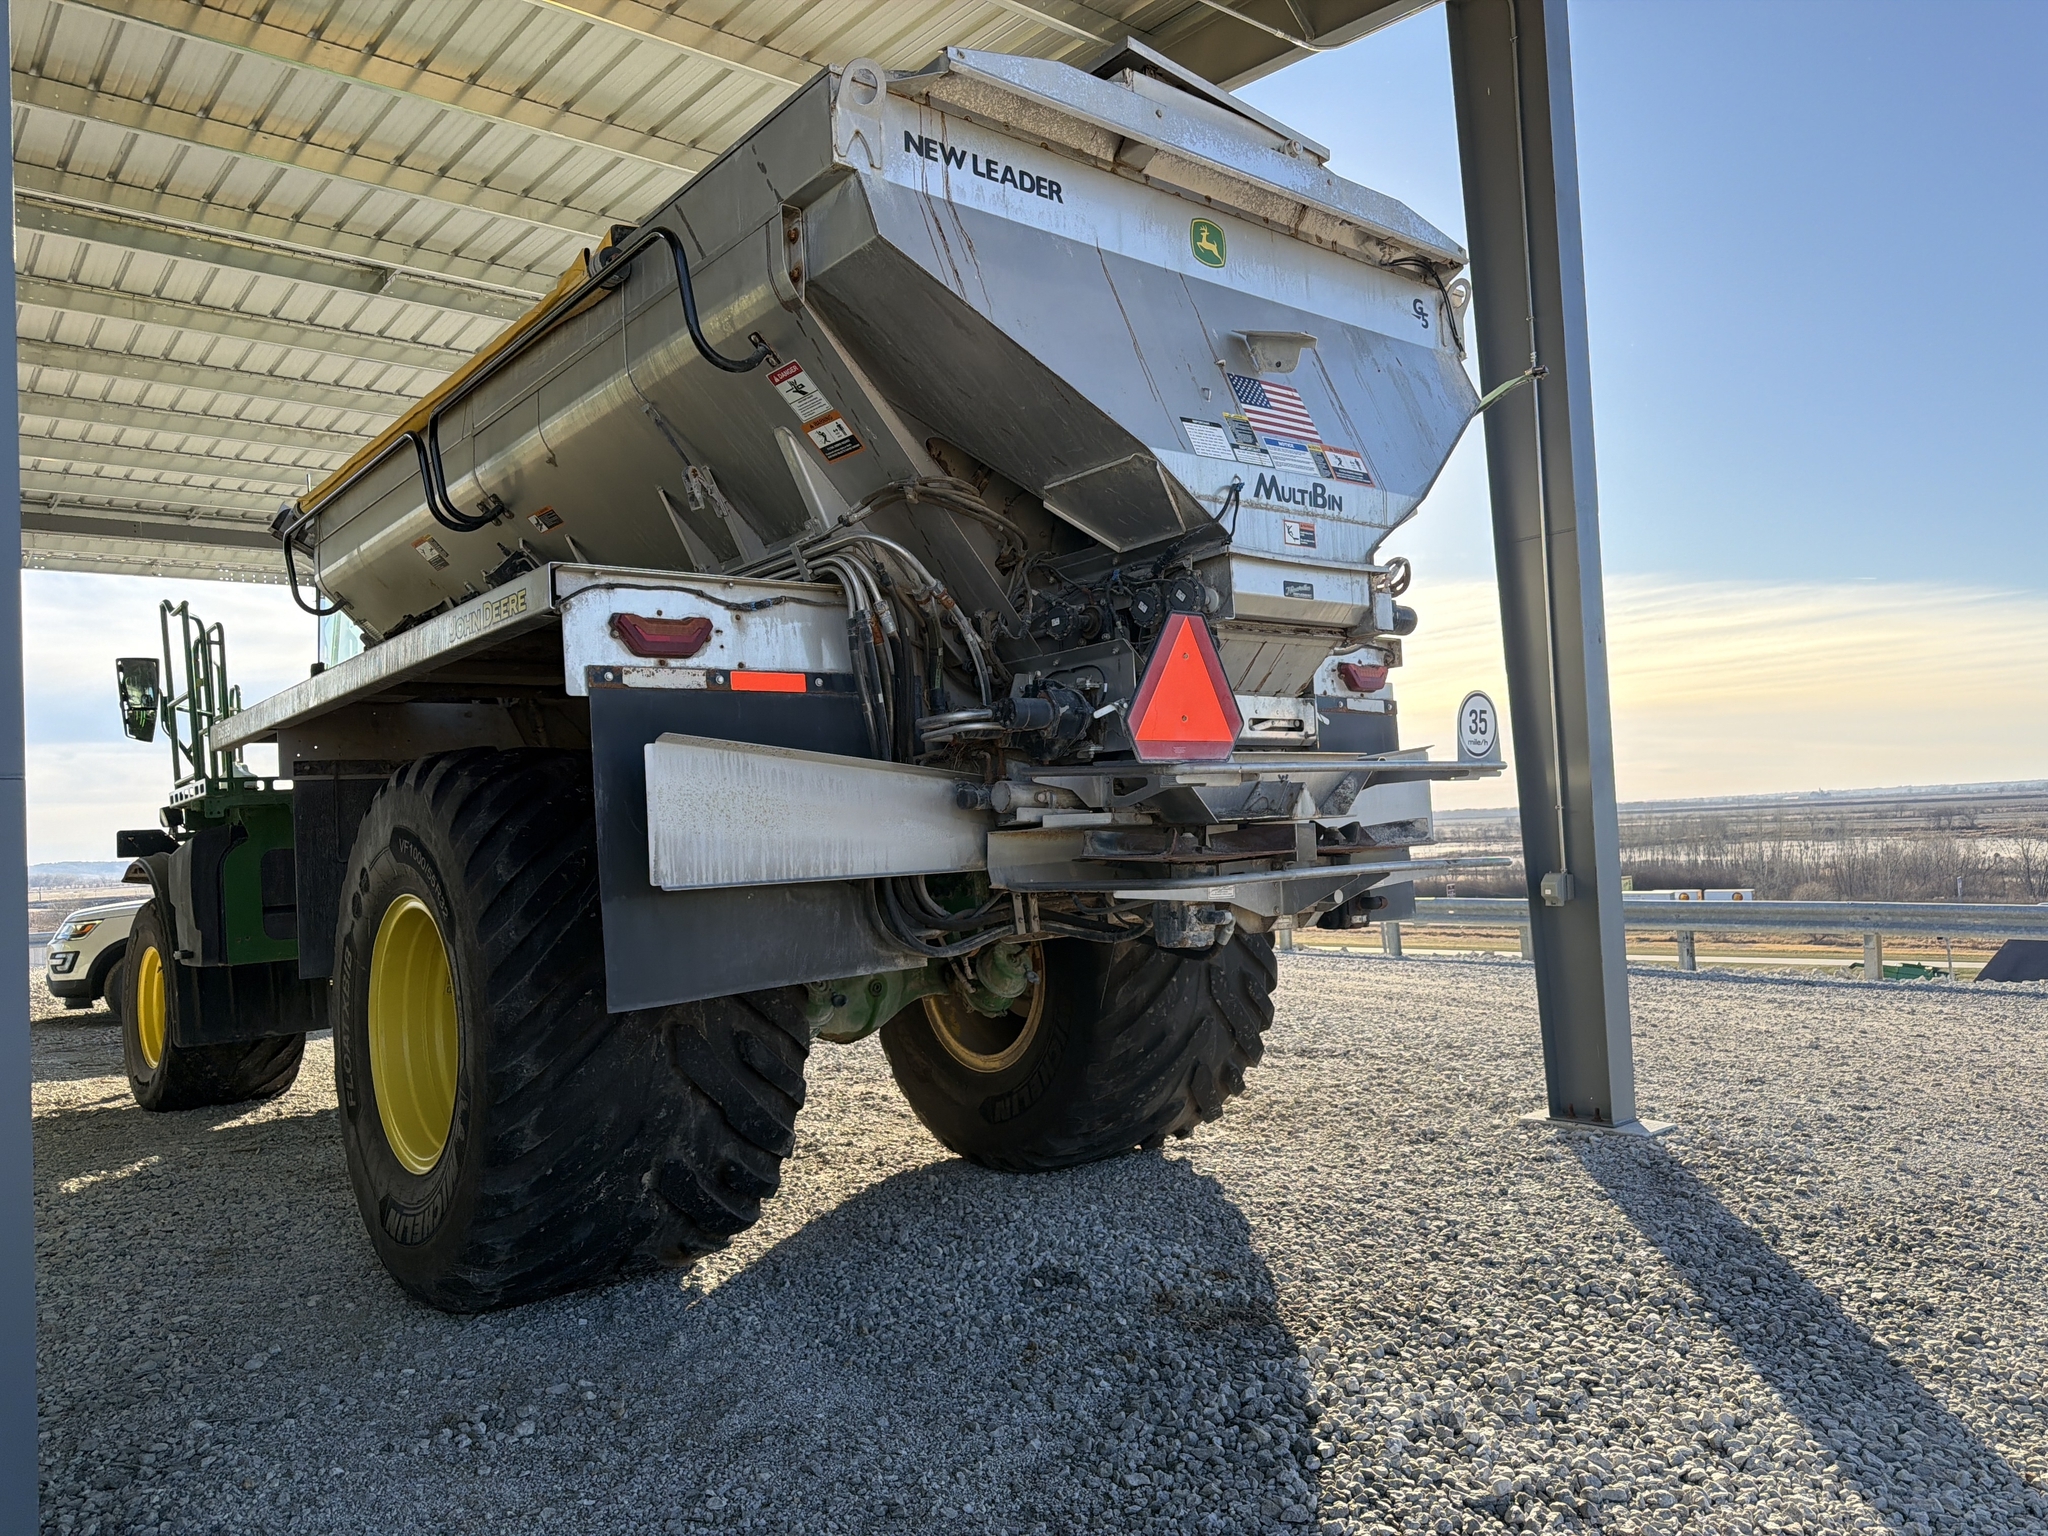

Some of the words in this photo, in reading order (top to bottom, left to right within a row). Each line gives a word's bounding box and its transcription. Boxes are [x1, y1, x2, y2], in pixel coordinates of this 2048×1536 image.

[904, 130, 967, 171] NEW
[972, 153, 1064, 204] LEADER
[777, 365, 799, 379] DANGER
[449, 608, 482, 644] JOHN
[482, 588, 527, 630] DEERE
[1469, 708, 1488, 735] 35
[342, 945, 357, 1107] FLOATXBIB
